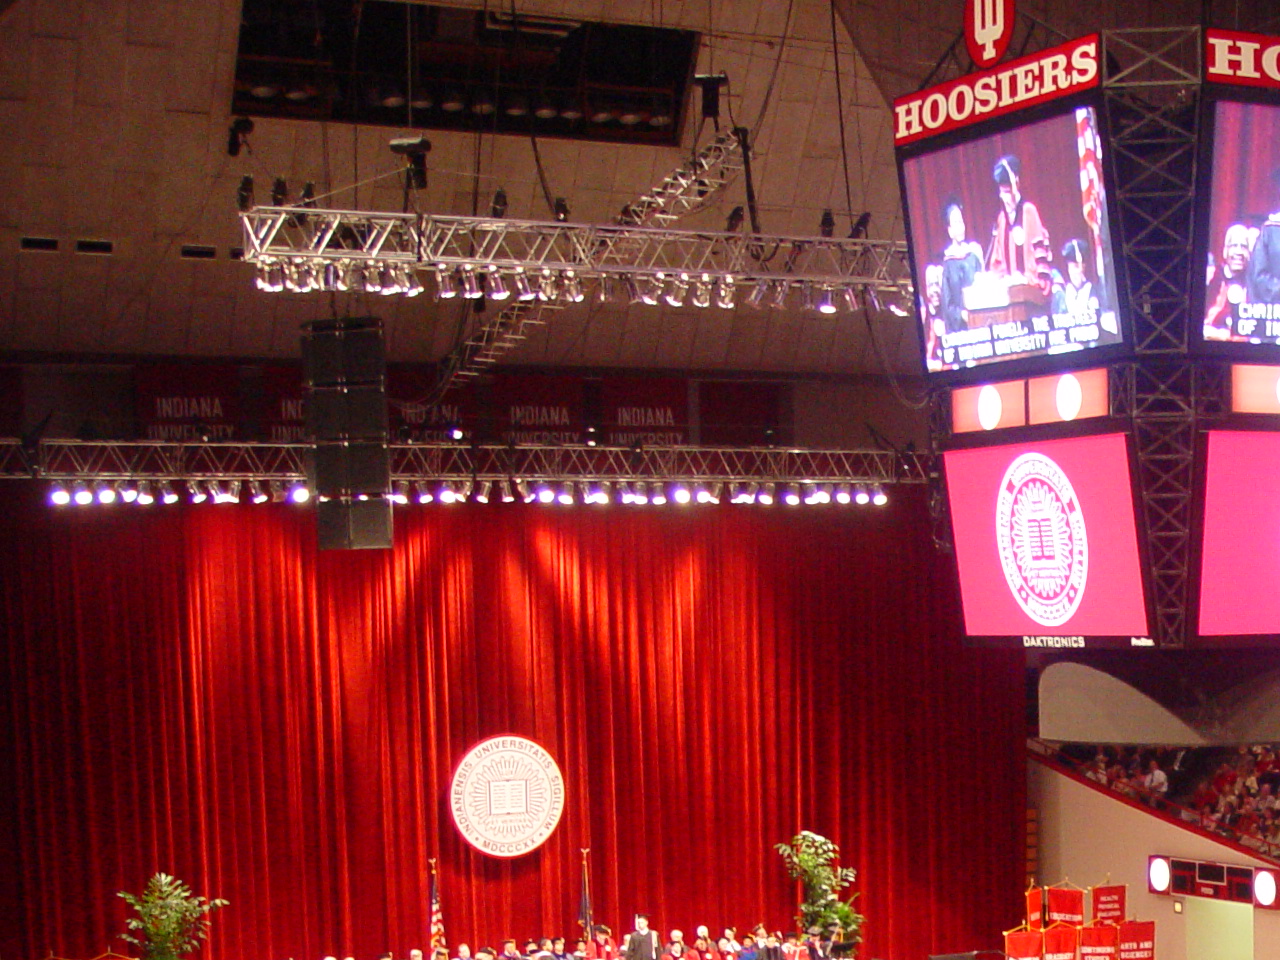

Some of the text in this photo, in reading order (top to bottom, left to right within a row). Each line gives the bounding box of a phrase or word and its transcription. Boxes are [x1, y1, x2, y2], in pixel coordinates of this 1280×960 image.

[895, 43, 1098, 139] HOOSIERS
[1238, 320, 1257, 335] OF
[156, 397, 223, 418] INDIANA
[617, 406, 674, 426] INDIANA
[1023, 636, 1086, 648] DAKTRONICS
[474, 739, 552, 770] UNIVERSITATIS
[543, 775, 561, 831] SIGILLUM
[482, 839, 537, 853] MDCCCXX
